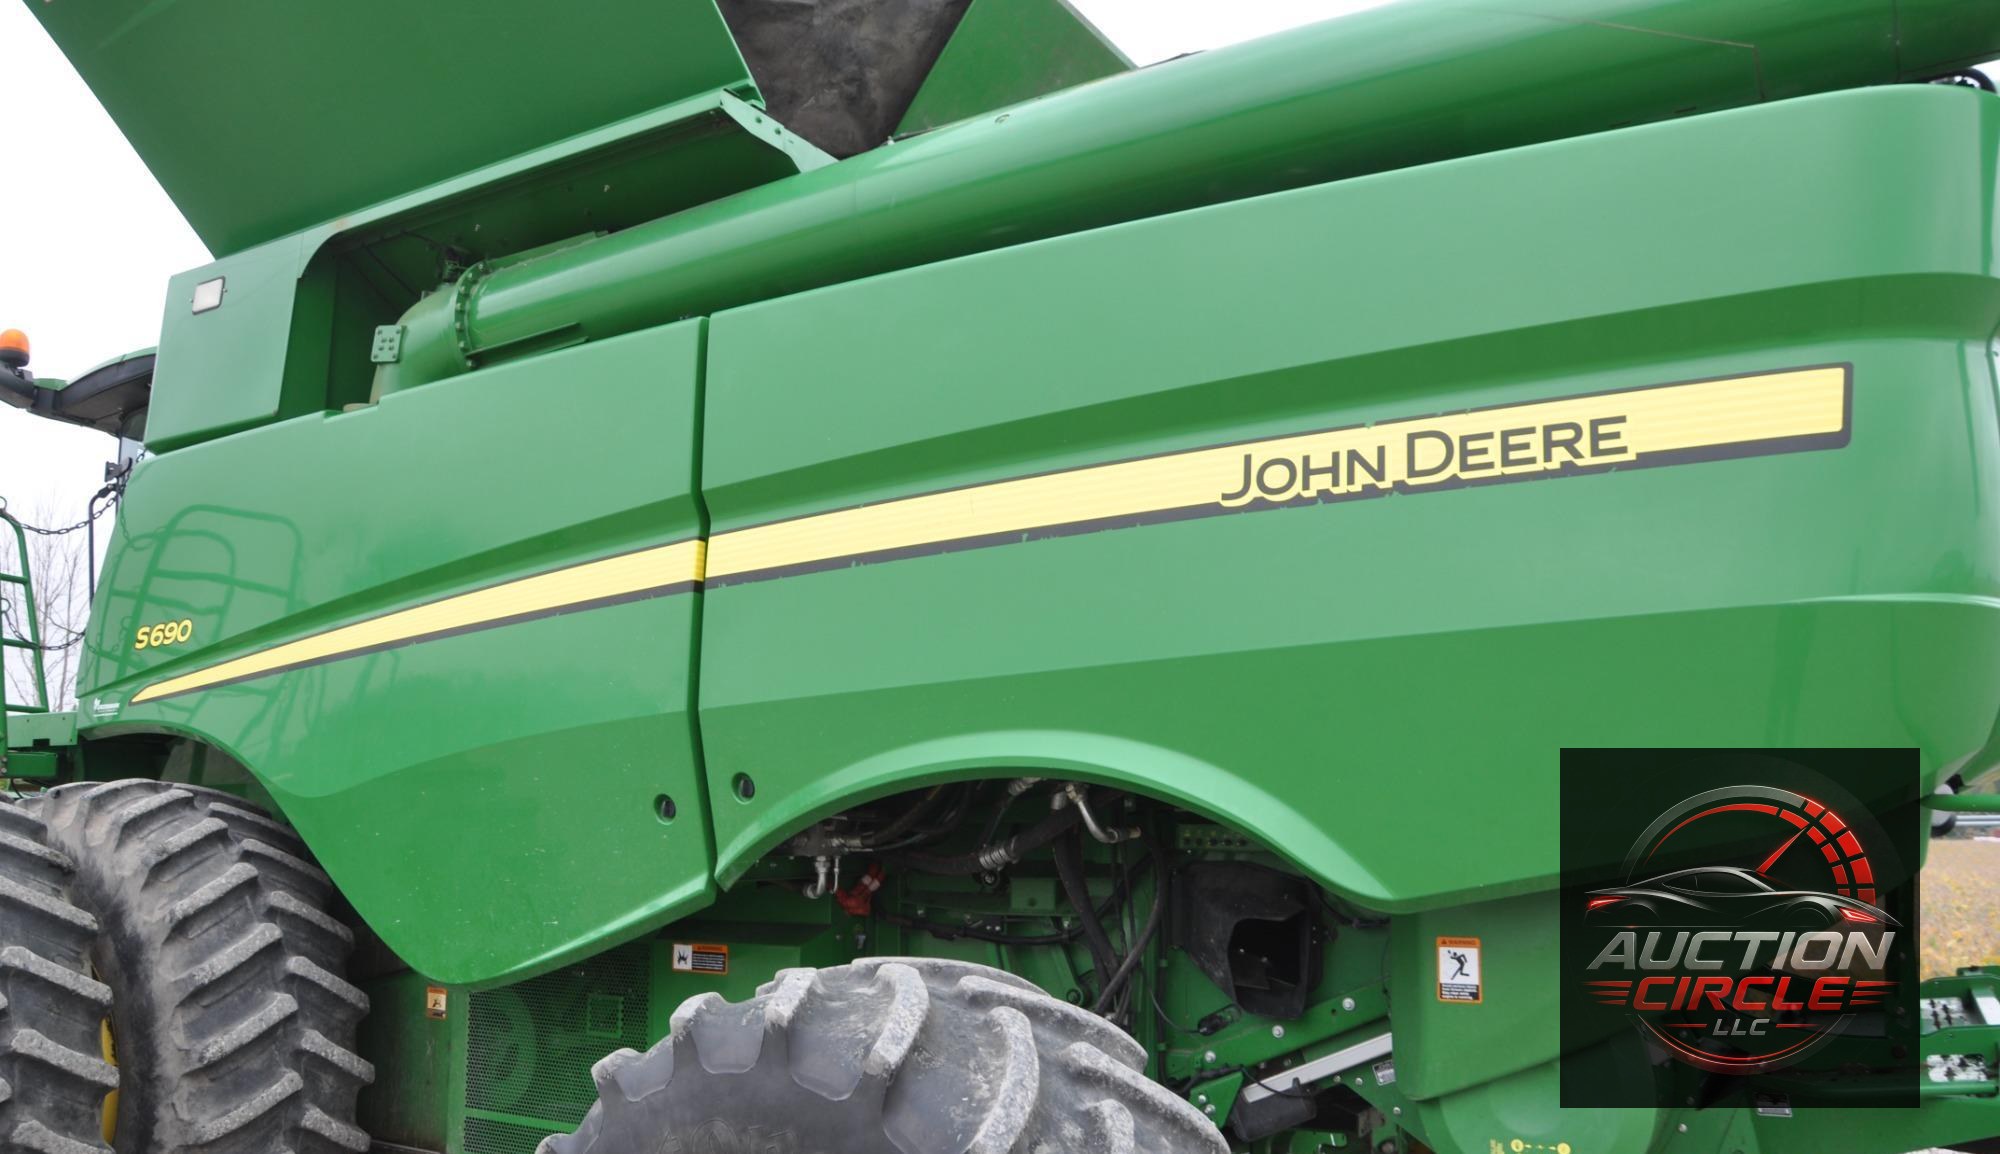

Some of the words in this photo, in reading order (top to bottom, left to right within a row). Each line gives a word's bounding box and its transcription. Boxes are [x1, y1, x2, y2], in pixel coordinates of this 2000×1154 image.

[1220, 445, 1386, 501] JOHN
[1406, 415, 1628, 478] DEERE
[134, 619, 193, 649] S690
